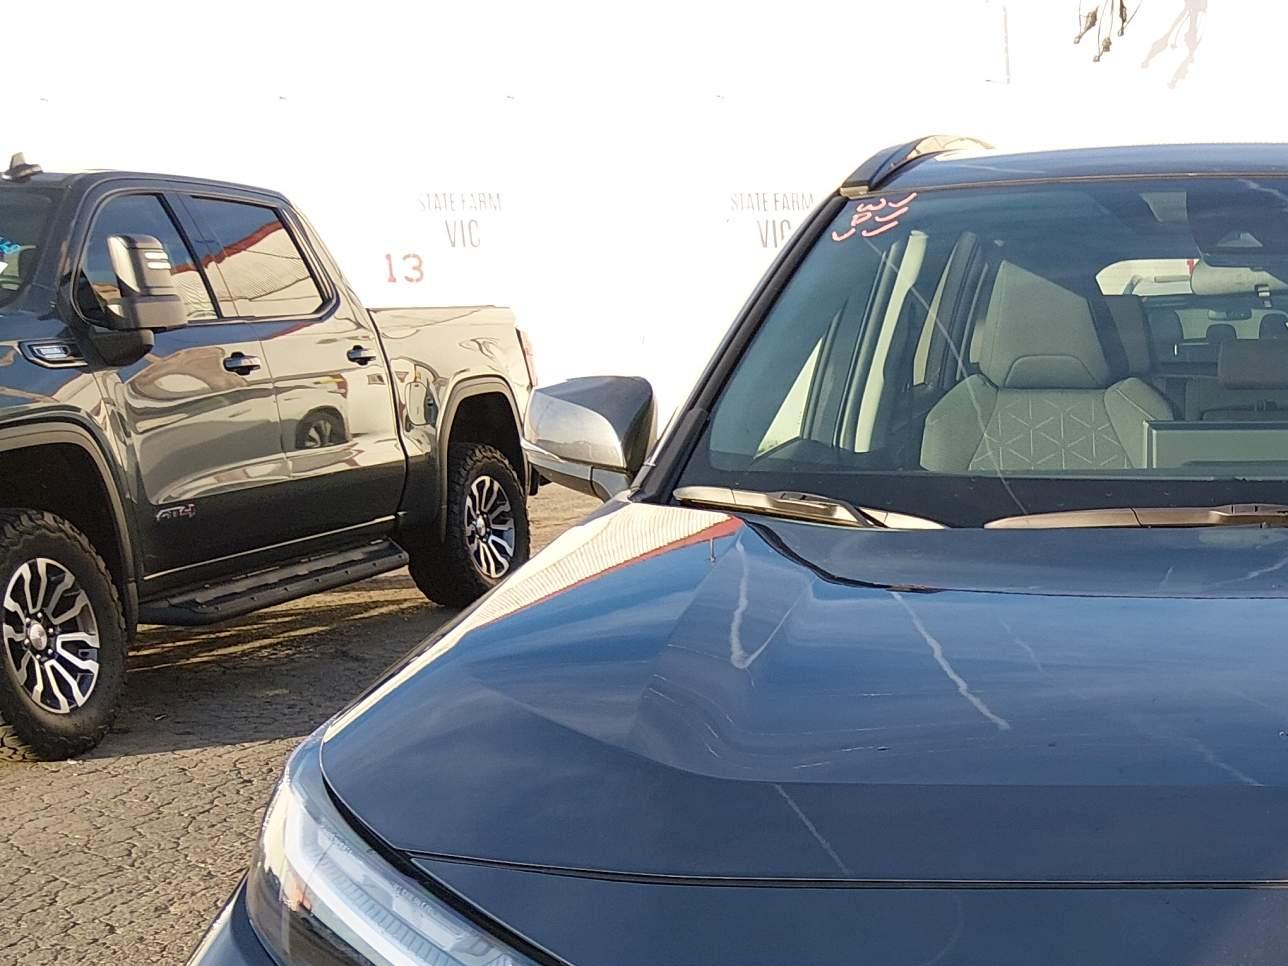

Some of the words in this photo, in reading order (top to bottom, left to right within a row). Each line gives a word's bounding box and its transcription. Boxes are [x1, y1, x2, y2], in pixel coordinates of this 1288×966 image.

[417, 192, 457, 212] STATE
[461, 192, 502, 212] FARM
[730, 192, 769, 212] STATE
[774, 192, 815, 212] FARM
[445, 219, 480, 248] VIC
[385, 253, 424, 283] 13
